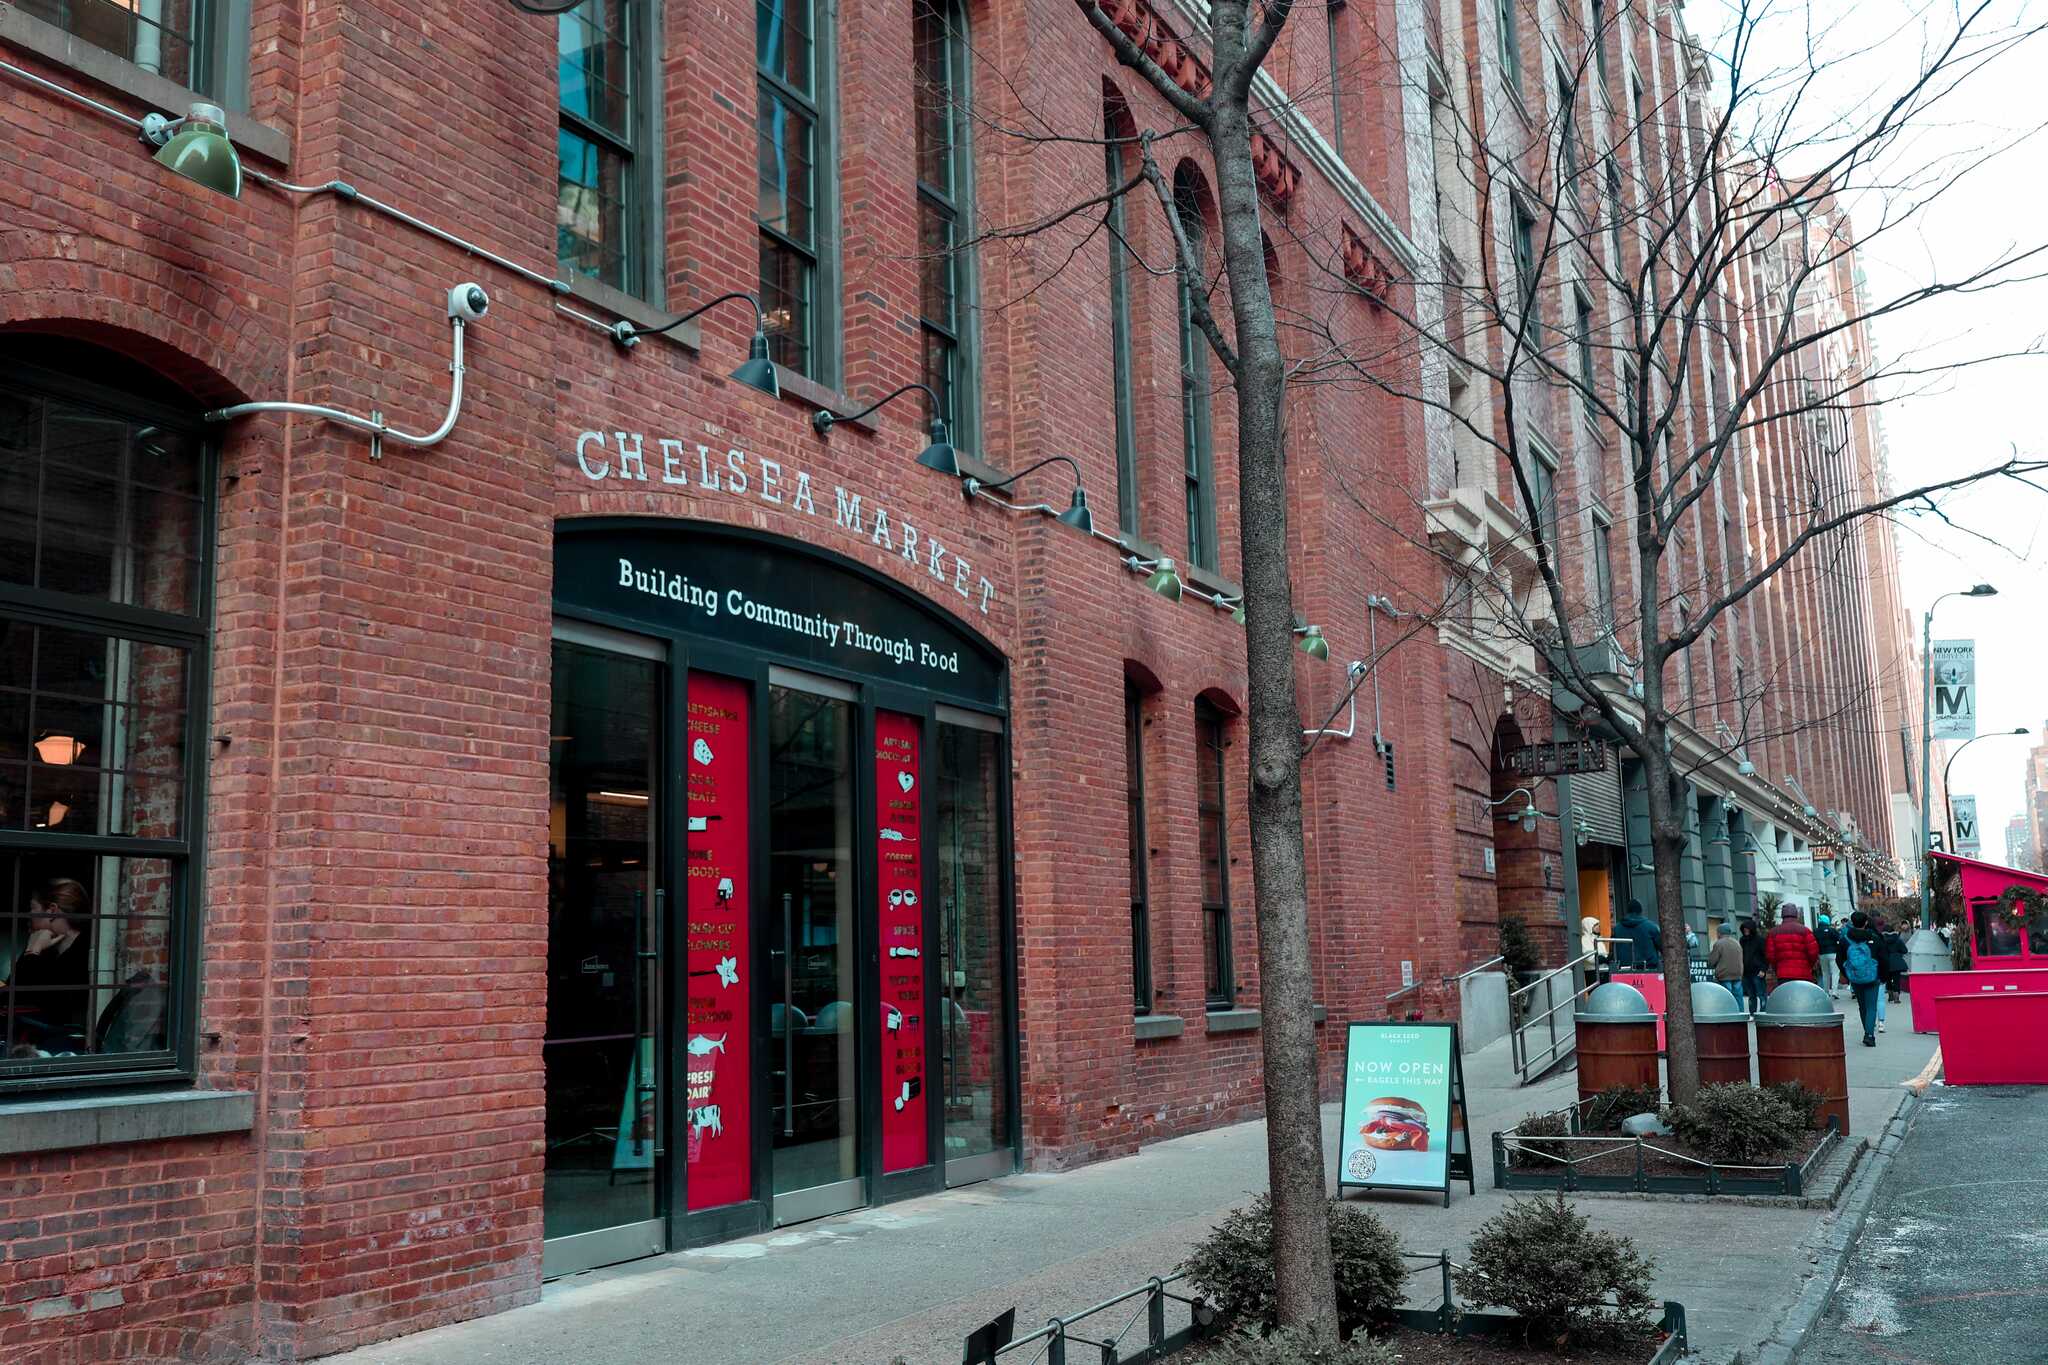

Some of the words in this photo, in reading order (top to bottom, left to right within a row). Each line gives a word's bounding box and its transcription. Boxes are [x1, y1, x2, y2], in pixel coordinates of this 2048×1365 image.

[576, 431, 817, 516] CHELSEA
[835, 485, 995, 615] MARKET
[618, 558, 719, 616] Building
[726, 589, 840, 648] Community
[843, 622, 915, 664] Through
[920, 642, 959, 674] Food
[1355, 1061, 1393, 1073] NOW
[1399, 1062, 1444, 1075] OPEN
[1367, 1076, 1399, 1085] BAGELS
[1401, 1077, 1422, 1085] THIS
[1423, 1078, 1443, 1086] WAY
